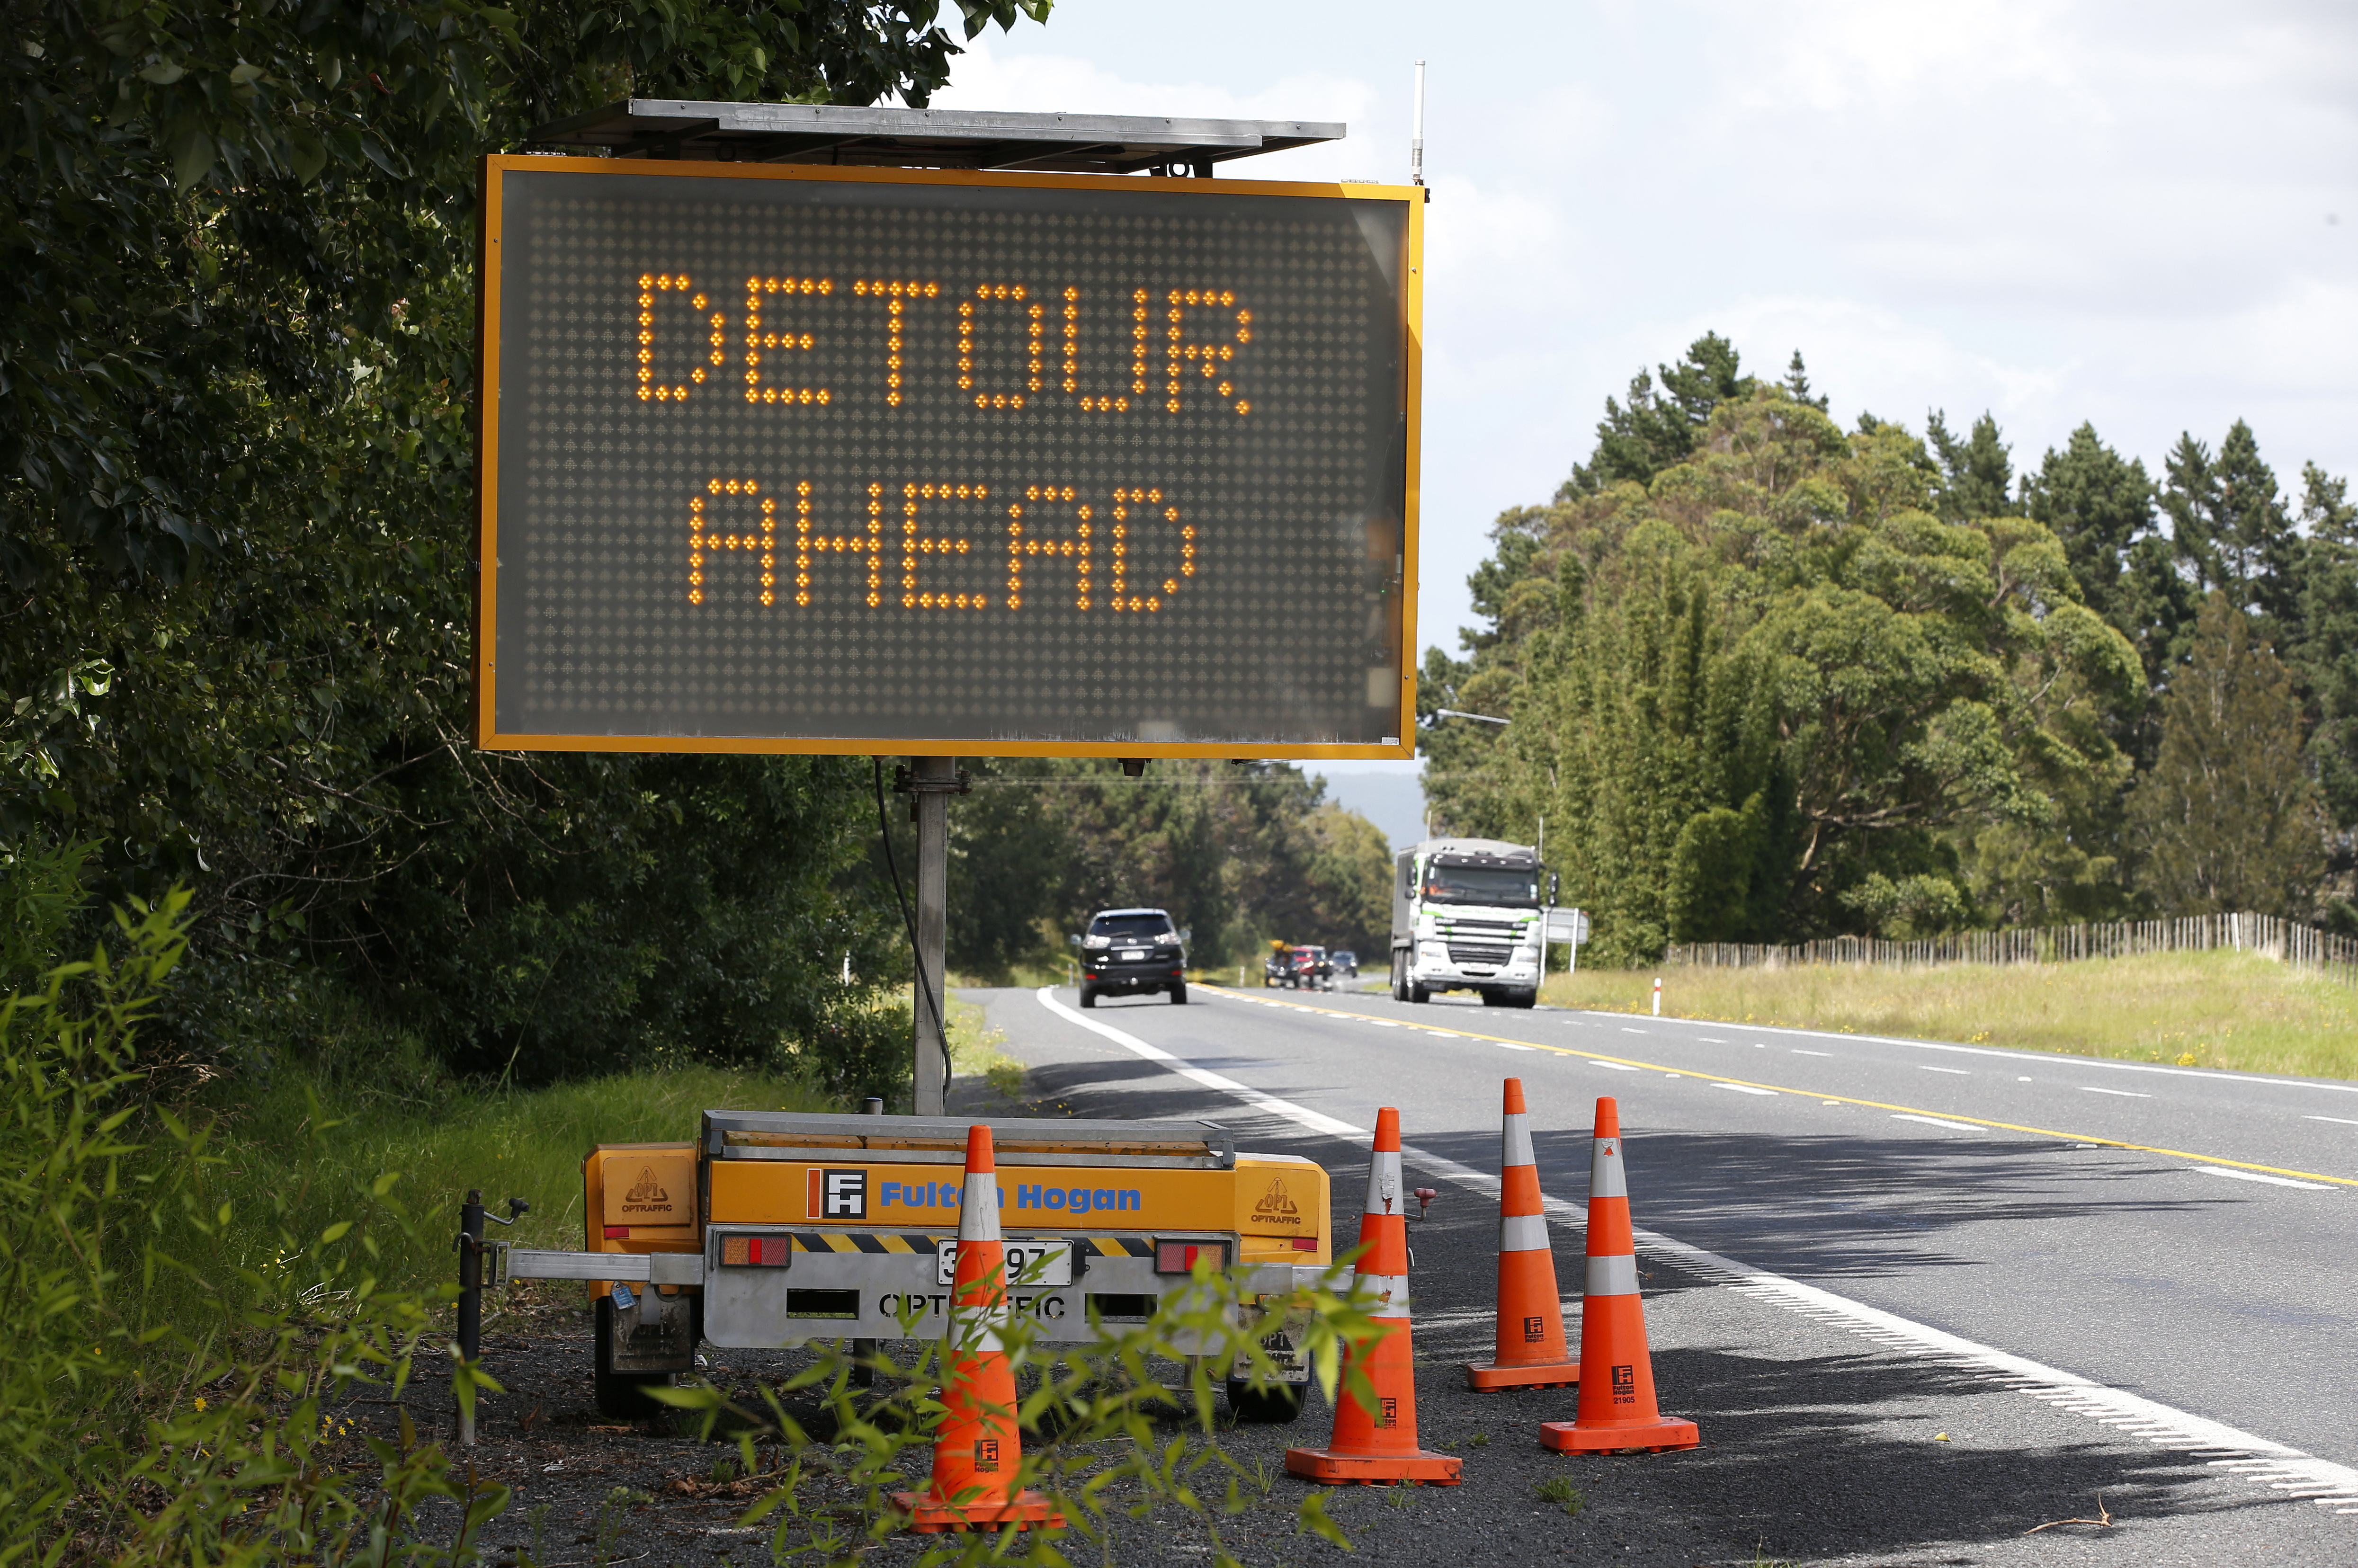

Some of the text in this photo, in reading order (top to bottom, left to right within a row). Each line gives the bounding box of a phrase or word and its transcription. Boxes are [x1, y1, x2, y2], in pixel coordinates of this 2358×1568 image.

[638, 271, 1252, 415] DETOUR
[688, 478, 1196, 611] AHEAD
[622, 1204, 672, 1212] OPTRAFFIC
[881, 1182, 1140, 1214] Fult Hogan
[1251, 1214, 1301, 1224] OPTRAFFIC
[879, 1293, 1065, 1319] OPTFIC
[1614, 1396, 1635, 1404] 21905
